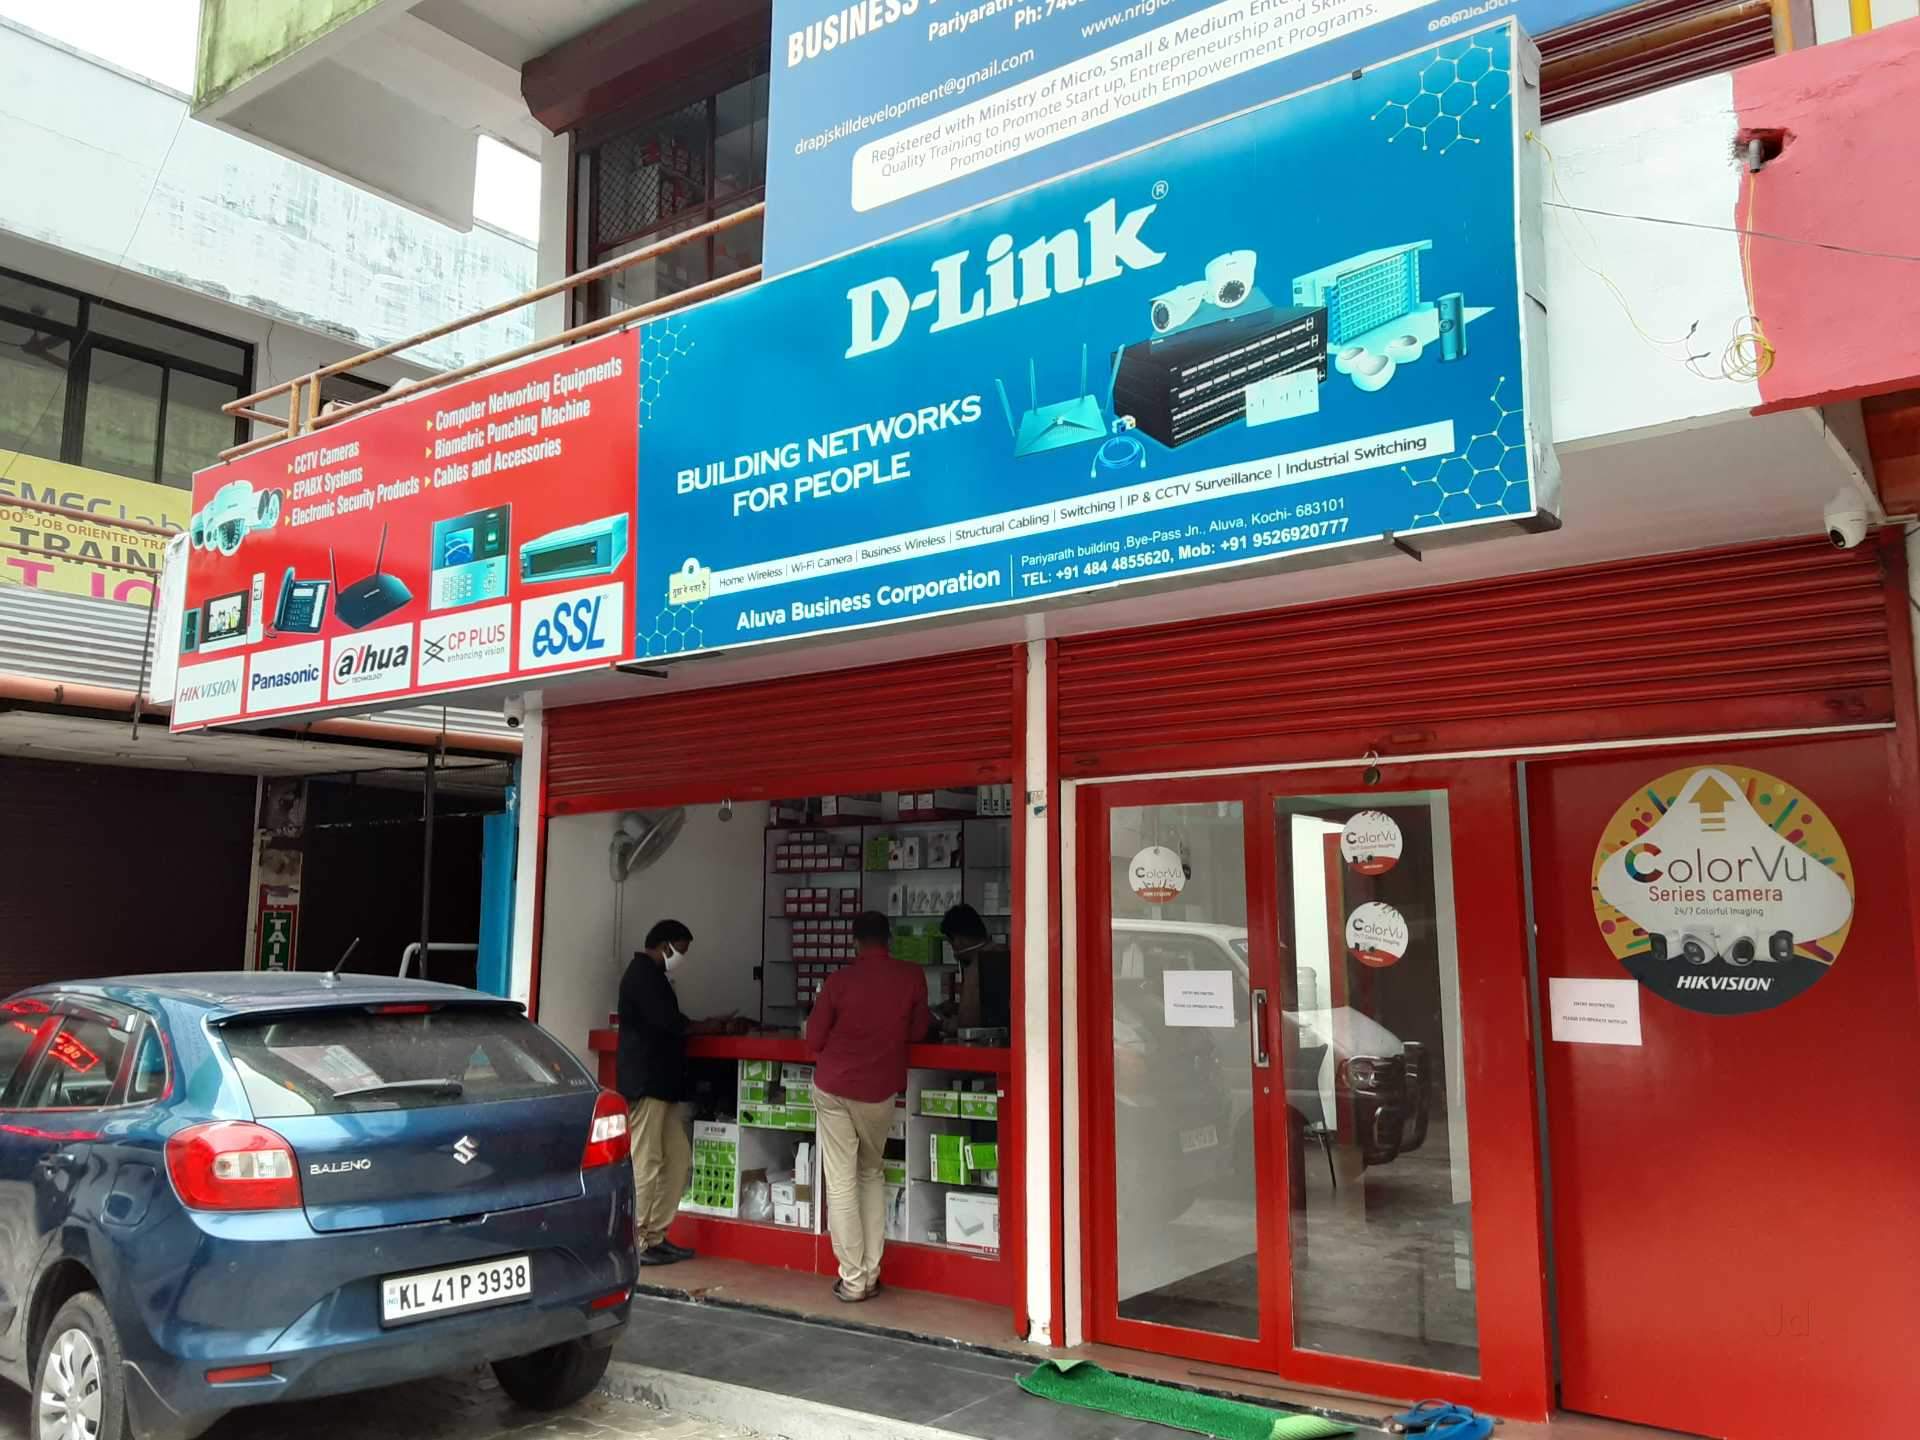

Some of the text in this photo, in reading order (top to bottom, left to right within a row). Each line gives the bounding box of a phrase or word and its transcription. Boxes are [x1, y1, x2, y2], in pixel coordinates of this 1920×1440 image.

[787, 0, 919, 68] BUSINESS
[1014, 5, 1042, 30] Ph:
[794, 48, 1035, 155] drapjskilldevelopment@gmail.com
[871, 127, 942, 164] Registered
[945, 114, 975, 136] with
[979, 90, 1037, 123] Ministry
[1041, 80, 1057, 98] of
[1060, 64, 1107, 91] Micro,
[1109, 41, 1153, 71] Small
[1157, 37, 1170, 52] &
[1173, 9, 1244, 46] Medium
[881, 151, 926, 177] Quality
[930, 131, 982, 161] Training
[985, 124, 999, 140] to
[1002, 101, 1062, 133] Promote
[1066, 83, 1100, 108] Start
[1104, 76, 1127, 93] up,
[1129, 20, 1269, 83] Entrepreneurship
[1273, 3, 1306, 28] and
[950, 3, 1378, 170] Promoting women and Youth Empowerment Programs.
[844, 198, 1167, 359] D-Link
[435, 356, 622, 431] Computer Networking Equipments
[435, 399, 591, 459] Biometric Punching Machine
[676, 394, 982, 495] BUILDING NETWORKS
[293, 466, 363, 500] EPABX Systems
[294, 441, 360, 474] CCTV Cameras
[434, 437, 561, 488] Cables and Accessories
[291, 475, 420, 527] Electronic Security Products
[732, 451, 911, 518] FOR PEOPLE
[34, 517, 63, 532] JOB
[66, 522, 139, 546] ORIENTED
[719, 435, 1427, 588] Home Wireless Wi-Fi Camera Business Wireless Structural Cabling Switching IP & CCTV Surveillance Industrial Switching
[1021, 550, 1075, 567] Pariyarath
[1077, 540, 1120, 558] building
[1295, 497, 1345, 518] 683101
[1021, 517, 1350, 588] TEL: +91 484 4855620, Mob: +91 9526920777
[736, 569, 1001, 631] Aluva Business Corporation
[448, 623, 506, 651] CP PLUS
[532, 595, 606, 659] eSSL
[251, 664, 320, 692] Panasonic
[447, 645, 506, 664] enhancing vision
[179, 678, 239, 702] HIKVISION
[1624, 842, 1808, 884] ColorVu
[1649, 886, 1784, 902] Series camera
[1695, 906, 1729, 916] Colorful
[1730, 906, 1765, 917] Imaging
[1676, 975, 1772, 992] HIKVISION
[309, 1158, 372, 1175] BALENO
[399, 1264, 526, 1311] KL 41 P 3938
